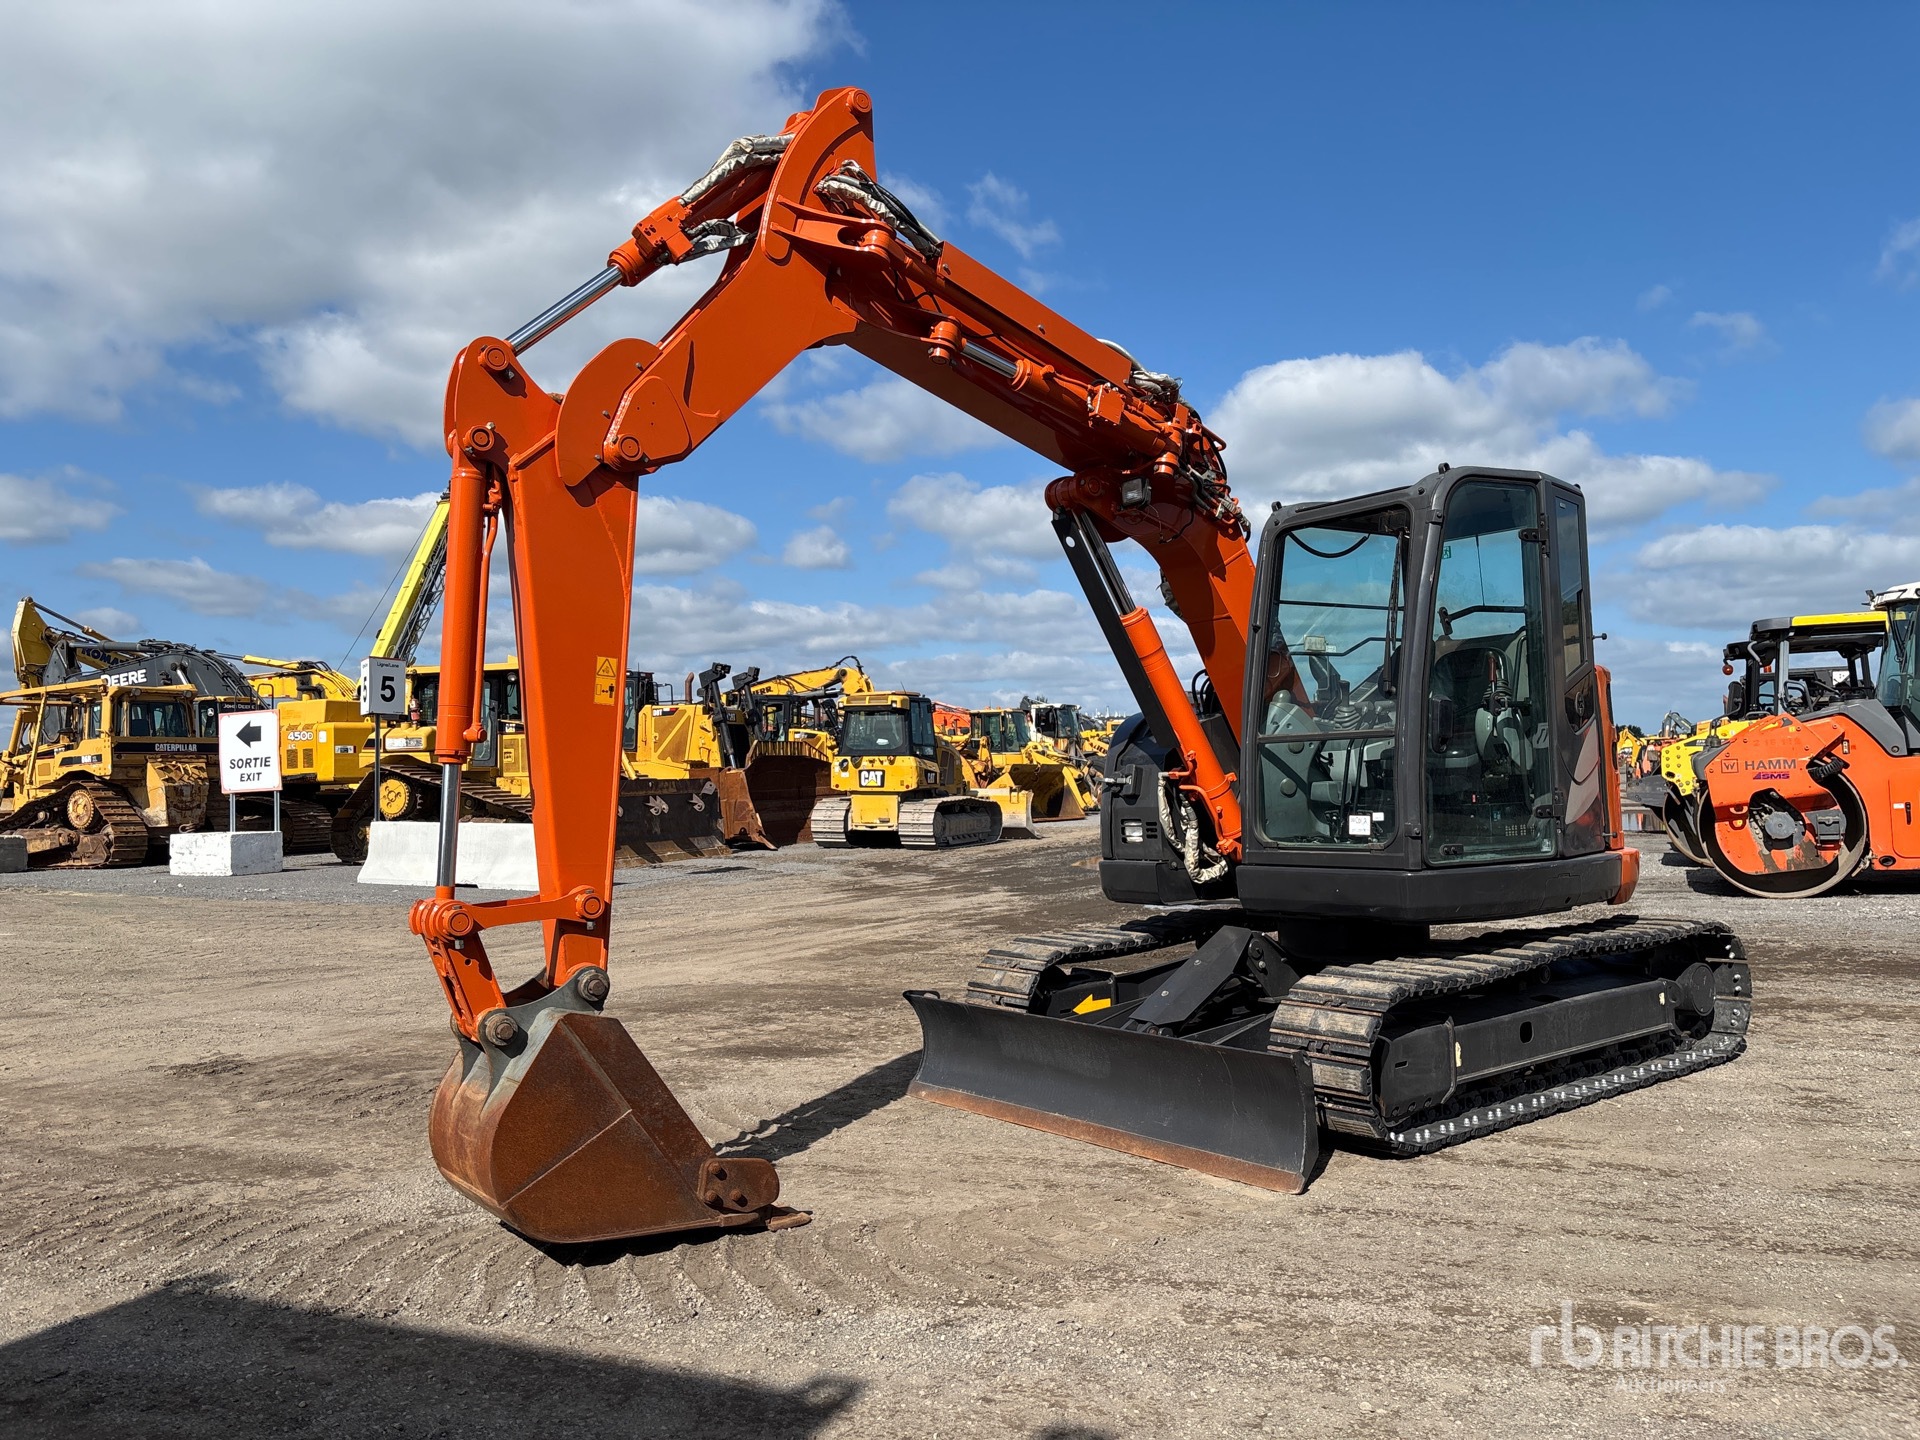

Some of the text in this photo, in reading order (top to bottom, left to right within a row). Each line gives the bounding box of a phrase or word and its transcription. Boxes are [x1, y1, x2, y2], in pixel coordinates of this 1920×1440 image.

[101, 669, 147, 687] DEERE
[380, 675, 396, 703] 5
[287, 731, 314, 741] 450D
[155, 743, 198, 752] CATERPILLAR
[229, 756, 271, 769] SORTIE
[1745, 759, 1796, 770] HAMM
[240, 772, 262, 782] EXIT
[861, 771, 883, 786] CAT
[927, 772, 936, 783] CAT
